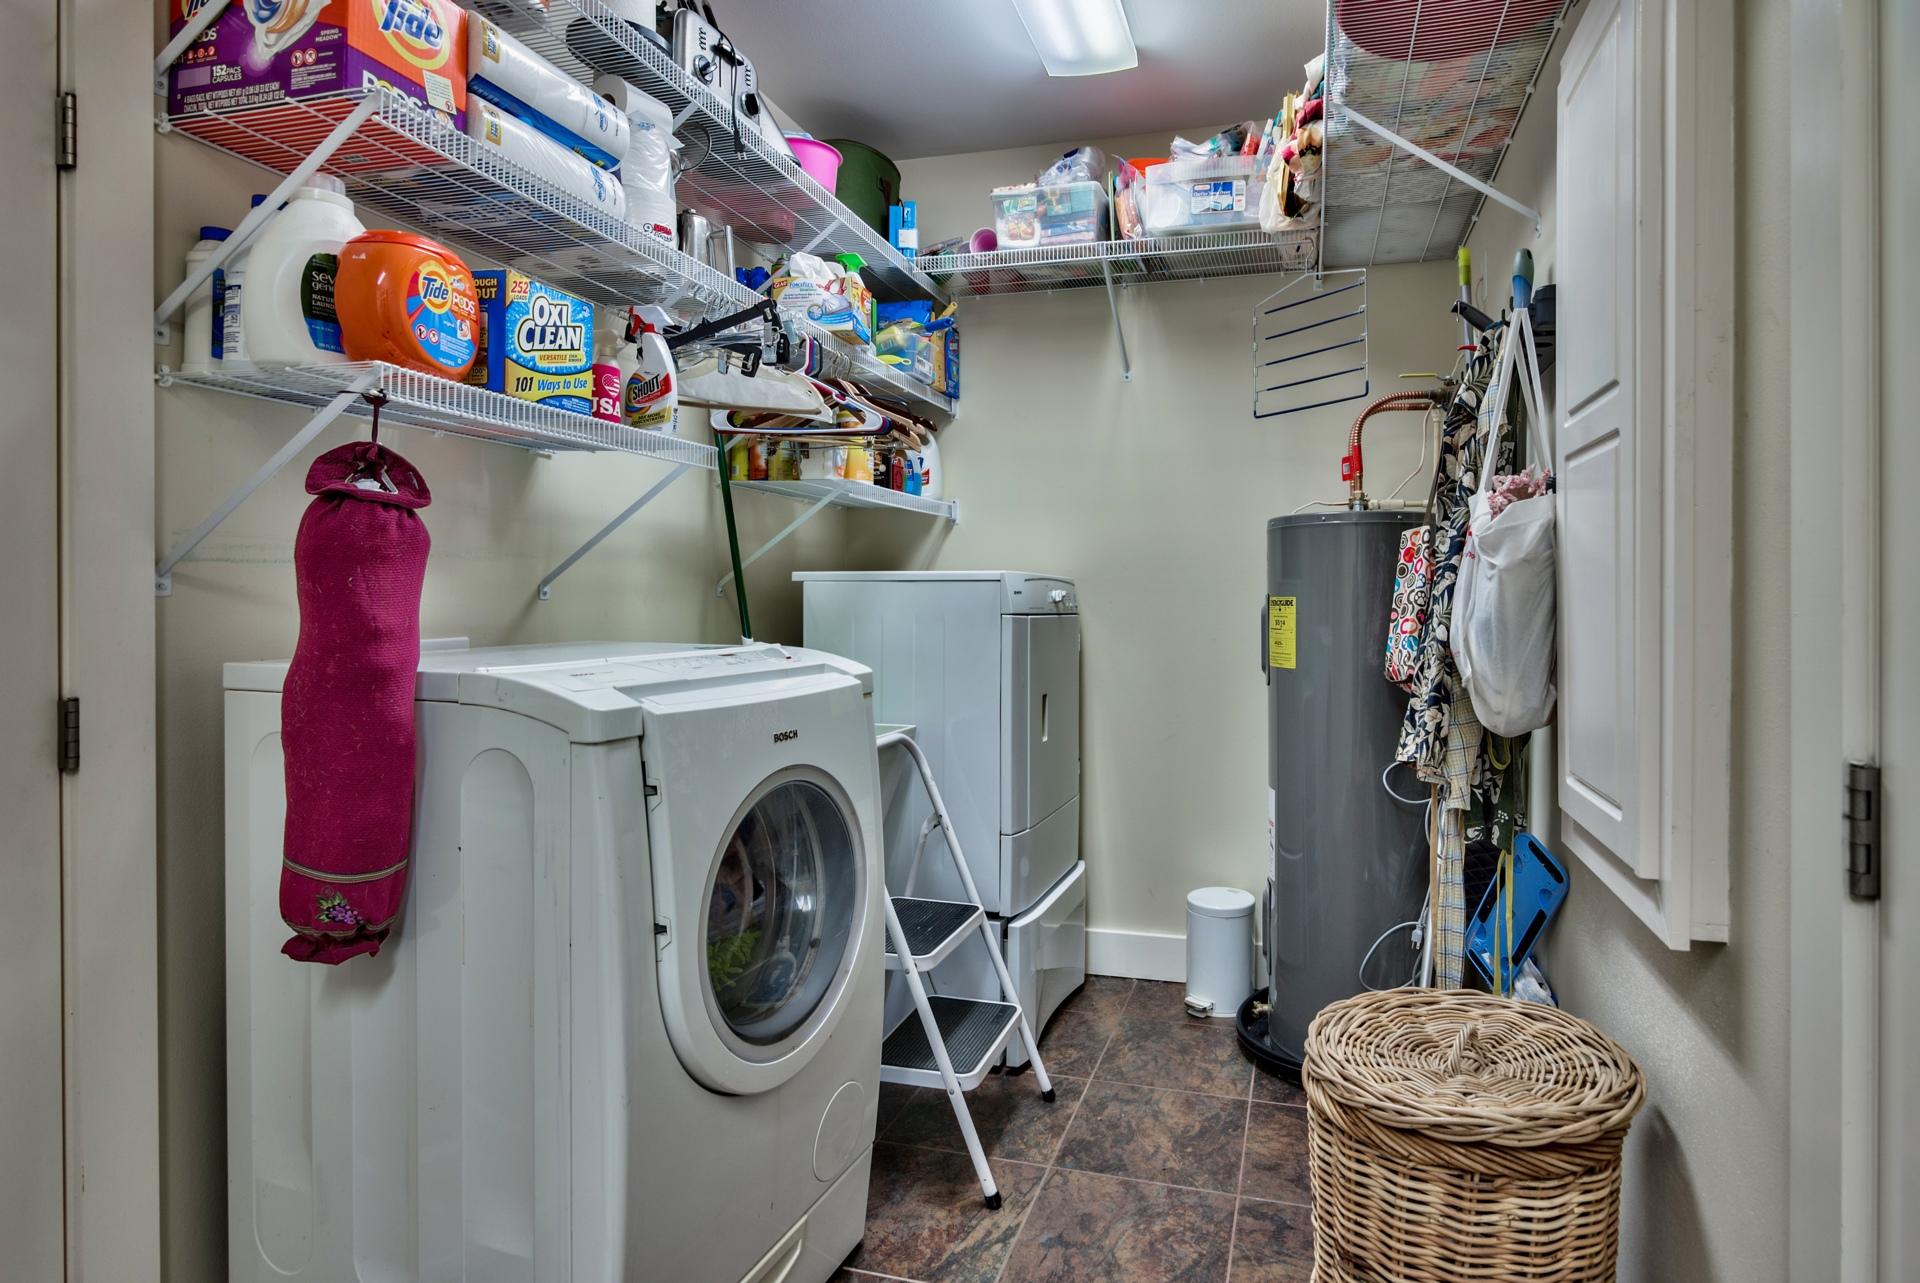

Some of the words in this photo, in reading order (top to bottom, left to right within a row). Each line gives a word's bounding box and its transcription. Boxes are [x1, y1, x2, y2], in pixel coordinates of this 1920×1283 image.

[212, 64, 227, 77] 152
[212, 73, 243, 84] CAPSULES
[422, 276, 449, 299] Tide
[475, 278, 498, 288] OUGH
[511, 280, 530, 294] 252
[452, 292, 476, 314] PODS
[532, 295, 569, 327] OXI
[518, 318, 583, 353] CLEAN
[515, 376, 535, 393] 101
[537, 378, 561, 393] Ways
[563, 380, 571, 390] to
[573, 377, 588, 390] Use
[632, 374, 660, 401] SHOUT
[773, 729, 799, 744] BOSCH
